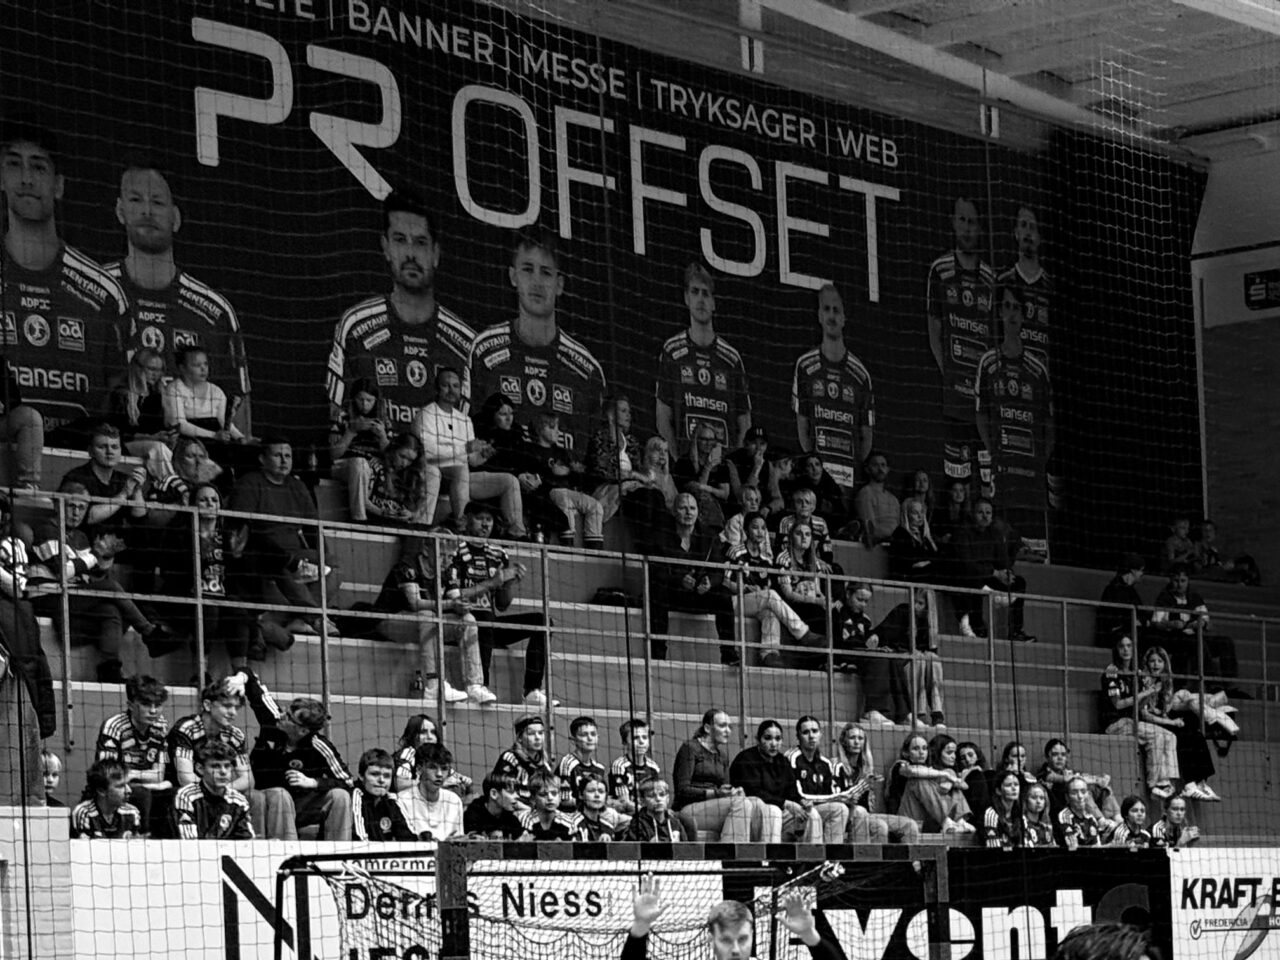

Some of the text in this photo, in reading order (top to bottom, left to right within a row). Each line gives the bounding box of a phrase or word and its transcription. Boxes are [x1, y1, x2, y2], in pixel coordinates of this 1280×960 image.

[350, 1, 899, 168] BANNER MESSE TRYKSAGER WEB
[451, 84, 900, 302] OFFSET
[8, 361, 89, 394] hansen
[685, 392, 728, 412] thansen
[815, 404, 854, 425] thansen
[502, 881, 602, 918] Niess
[1181, 876, 1263, 910] KRAFT
